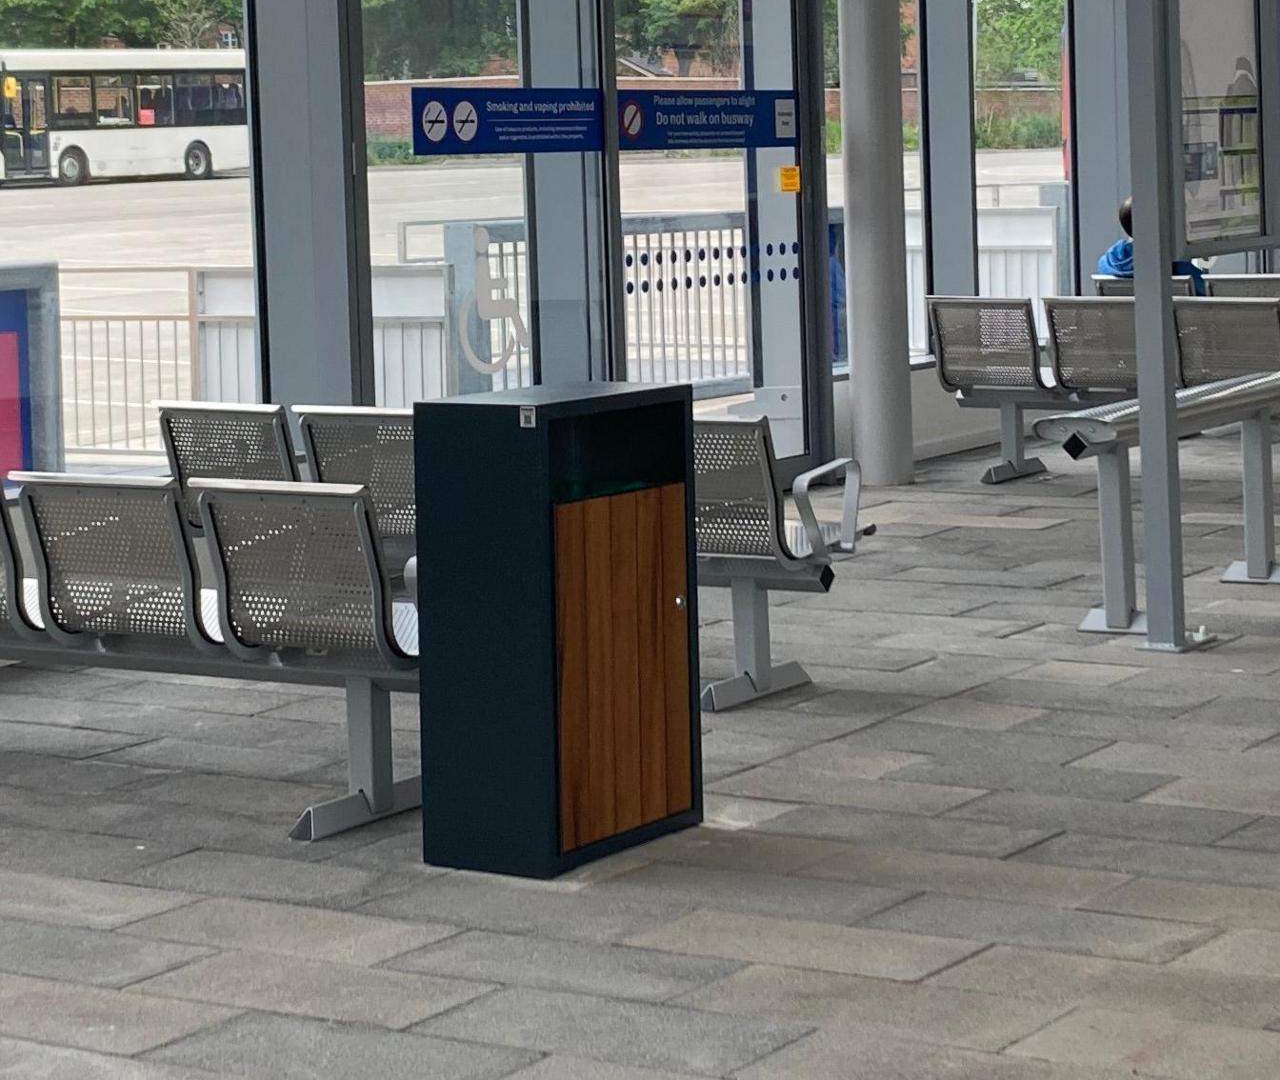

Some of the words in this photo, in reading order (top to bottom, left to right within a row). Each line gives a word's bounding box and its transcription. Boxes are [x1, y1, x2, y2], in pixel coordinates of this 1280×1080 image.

[486, 101, 519, 114] Smoking
[519, 101, 533, 112] and
[534, 102, 558, 114] vaping
[558, 101, 595, 114] prohibited
[653, 95, 675, 106] Please
[676, 96, 693, 106] allow
[694, 97, 730, 108] passengers
[731, 96, 738, 105] to
[738, 95, 756, 108] alight
[656, 111, 668, 125] Do
[670, 112, 685, 125] not
[686, 111, 707, 125] walk
[709, 114, 720, 125] on
[721, 112, 754, 128] busway
